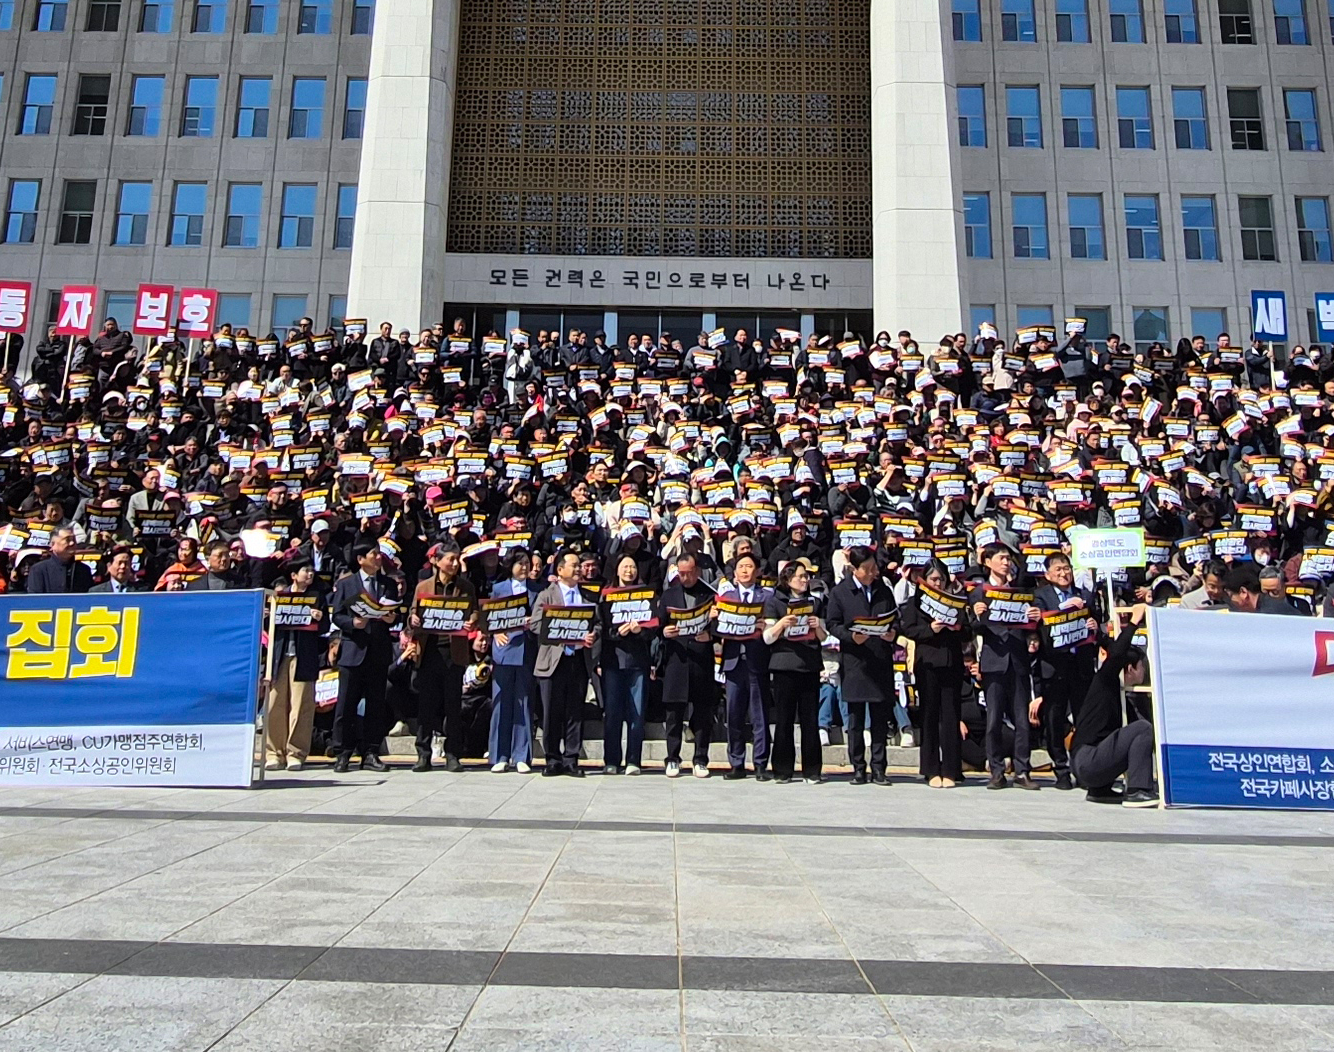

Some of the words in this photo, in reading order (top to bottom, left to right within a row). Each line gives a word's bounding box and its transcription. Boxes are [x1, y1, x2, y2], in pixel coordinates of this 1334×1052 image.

[489, 269, 529, 288] 모든
[545, 269, 607, 289] 권력은
[622, 270, 751, 290] 국민으로부터
[767, 272, 830, 291] 나온다
[136, 291, 212, 332] 보호
[5, 605, 140, 680] 집회
[81, 732, 207, 752] CU가맹점주연합회,
[1208, 752, 1316, 775] 전국상인연합회,
